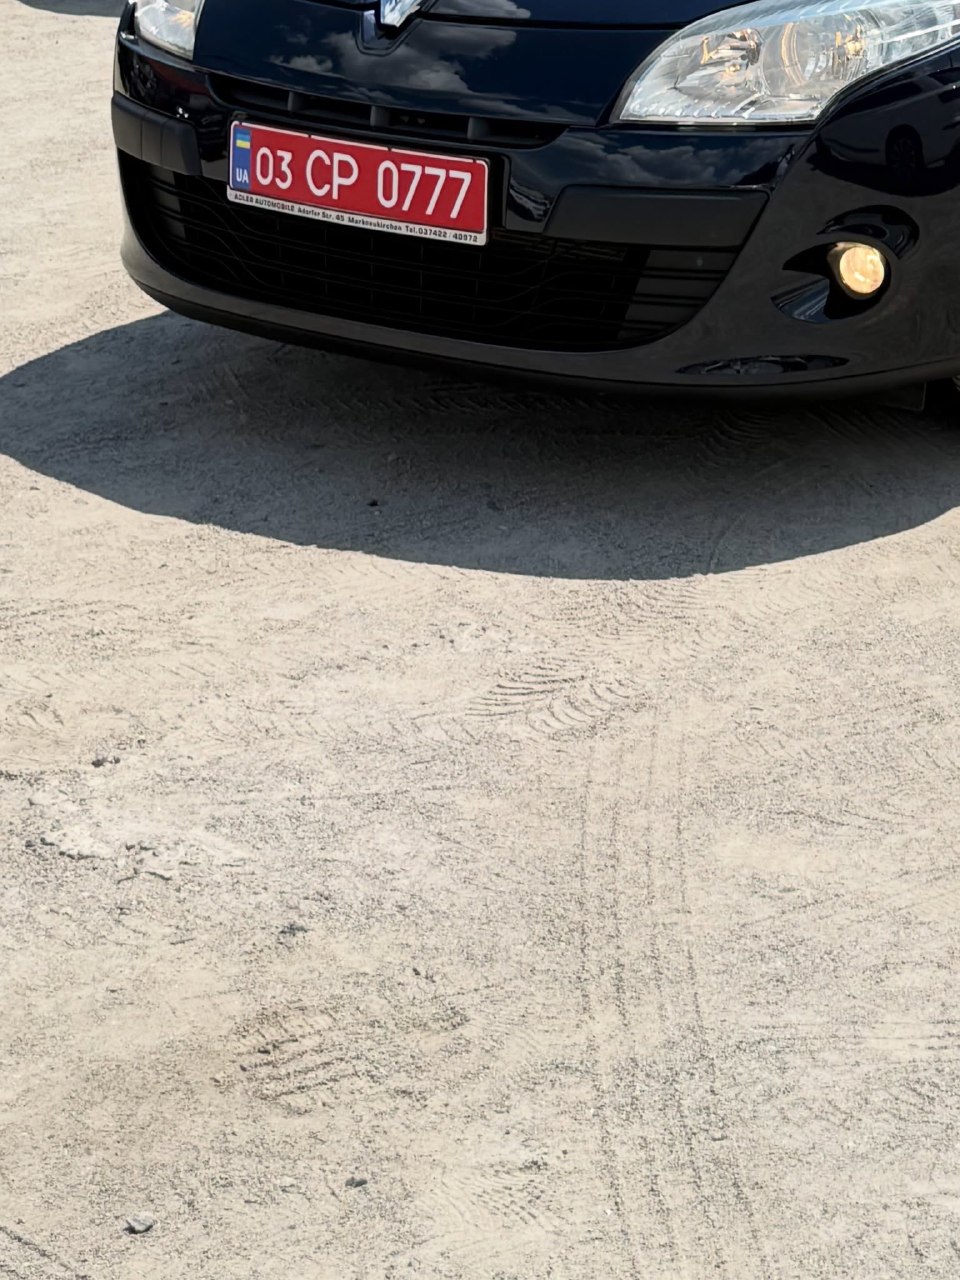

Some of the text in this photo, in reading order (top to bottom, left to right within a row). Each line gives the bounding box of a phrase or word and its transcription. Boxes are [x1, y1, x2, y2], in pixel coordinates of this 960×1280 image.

[236, 168, 249, 184] UA
[255, 147, 293, 189] 03
[377, 160, 472, 219] 0777
[234, 193, 254, 203] ADLER
[255, 198, 295, 212] AUTOMOBILE
